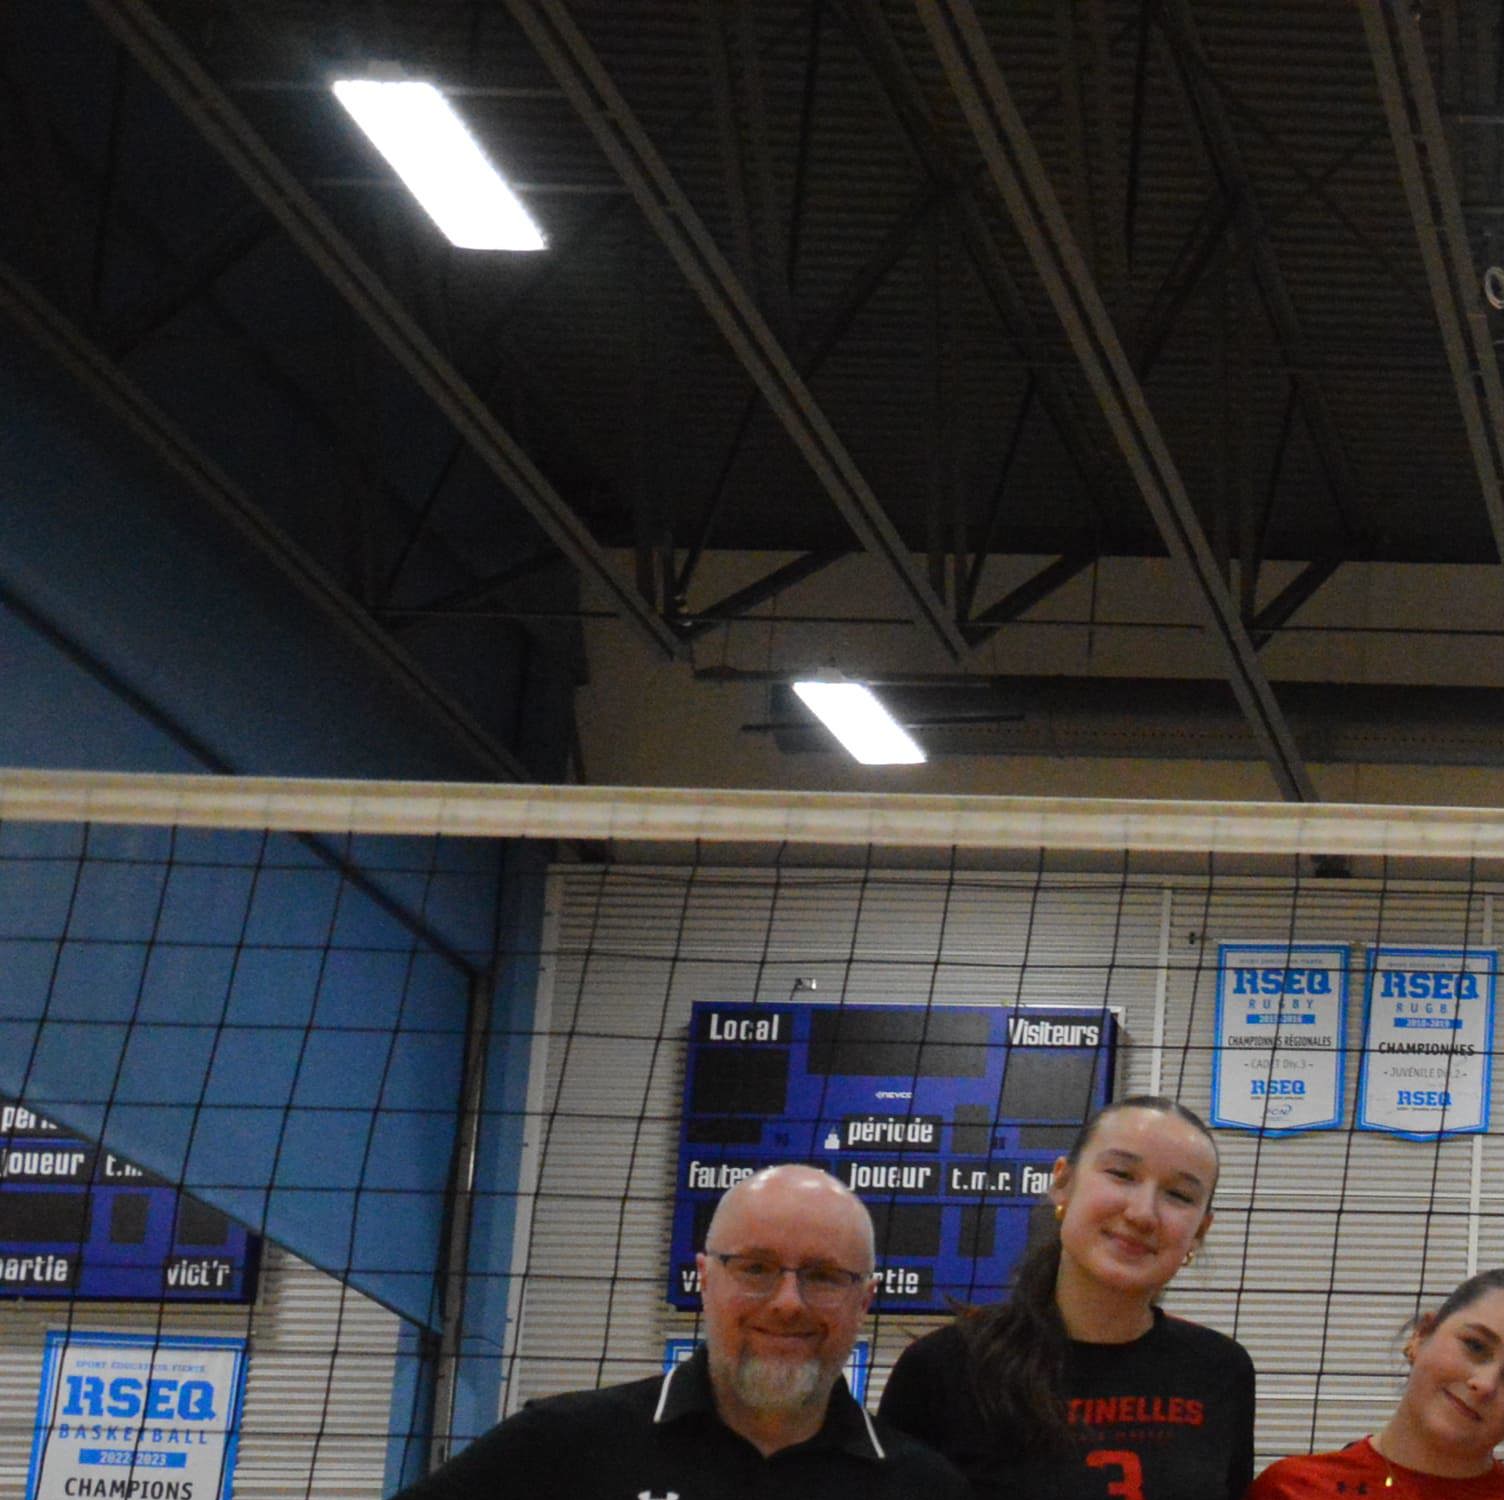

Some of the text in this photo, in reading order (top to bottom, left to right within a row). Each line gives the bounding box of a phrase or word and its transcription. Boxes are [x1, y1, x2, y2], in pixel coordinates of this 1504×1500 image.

[1233, 968, 1332, 995] RSEQ
[1380, 972, 1479, 1000] RSEQ
[1396, 1003, 1460, 1014] RUGB
[709, 1013, 780, 1041] Local
[1009, 1017, 1099, 1046] Visiteurs
[1228, 1035, 1282, 1047] CHAMPIONNS
[1378, 1042, 1476, 1056] CHAMPIONNES
[1250, 1079, 1306, 1095] RSEQ
[1396, 1090, 1452, 1106] RSEQ
[848, 1117, 933, 1146] période
[688, 1161, 754, 1189] fautes
[849, 1163, 931, 1191] joueur
[951, 1167, 1012, 1191] t.m.r.
[1021, 1166, 1054, 1195] fau
[167, 1259, 231, 1287] vict'r
[62, 1375, 216, 1422] RSEQ
[1066, 1394, 1206, 1428] TINELLES
[100, 1450, 167, 1467] 20222023
